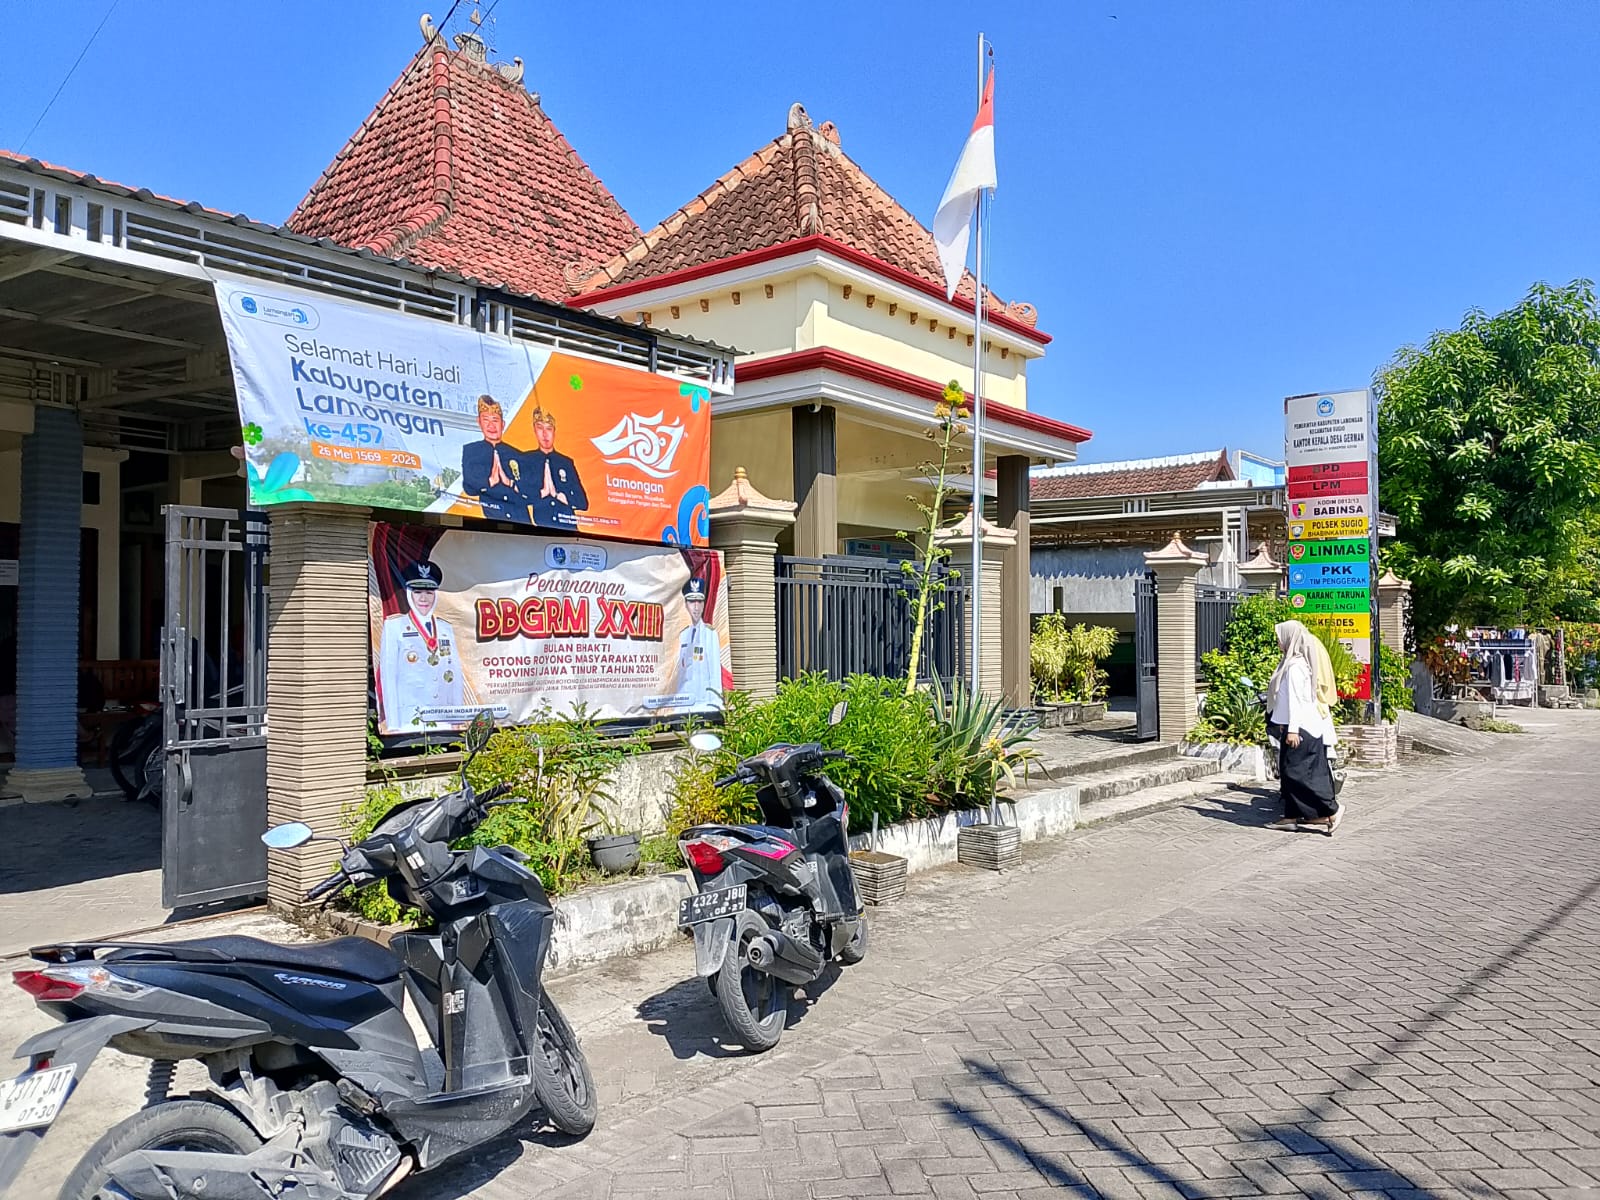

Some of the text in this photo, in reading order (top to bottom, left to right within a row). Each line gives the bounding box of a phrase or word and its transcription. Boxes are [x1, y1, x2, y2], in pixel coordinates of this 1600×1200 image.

[285, 334, 461, 384] Selamat Hari Jadi
[291, 357, 443, 409] Kabupaten
[296, 387, 444, 436] Lamongan
[304, 417, 383, 444] ke-457
[1294, 432, 1364, 448] KANTOR KEPALA DESA GERMAN
[318, 445, 331, 456] 26
[334, 449, 353, 459] Mei
[356, 450, 381, 462] 1569
[392, 453, 416, 466] 2026
[606, 474, 664, 494] Lamongan
[1312, 481, 1340, 490] LPM
[1314, 506, 1364, 516] BABINSA
[1312, 519, 1363, 530] POLSEK SUGIO
[1310, 544, 1366, 557] LINMAS
[1322, 566, 1352, 576] PKK
[526, 572, 627, 599] Pencanangan
[1322, 577, 1366, 585] PENGGERAK
[1306, 590, 1366, 600] KARANG TARUNA
[475, 596, 664, 643] BBGRM XXIII
[544, 643, 610, 654] BULAN BHAKTI
[482, 654, 658, 667] GOTONG ROYONG MASYARAKAT XXIII
[489, 664, 655, 679] PROVINSI JAWA TIMUR TAHUN 2026
[680, 887, 744, 911] S 4322 JBU
[43, 1070, 72, 1095] JAT
